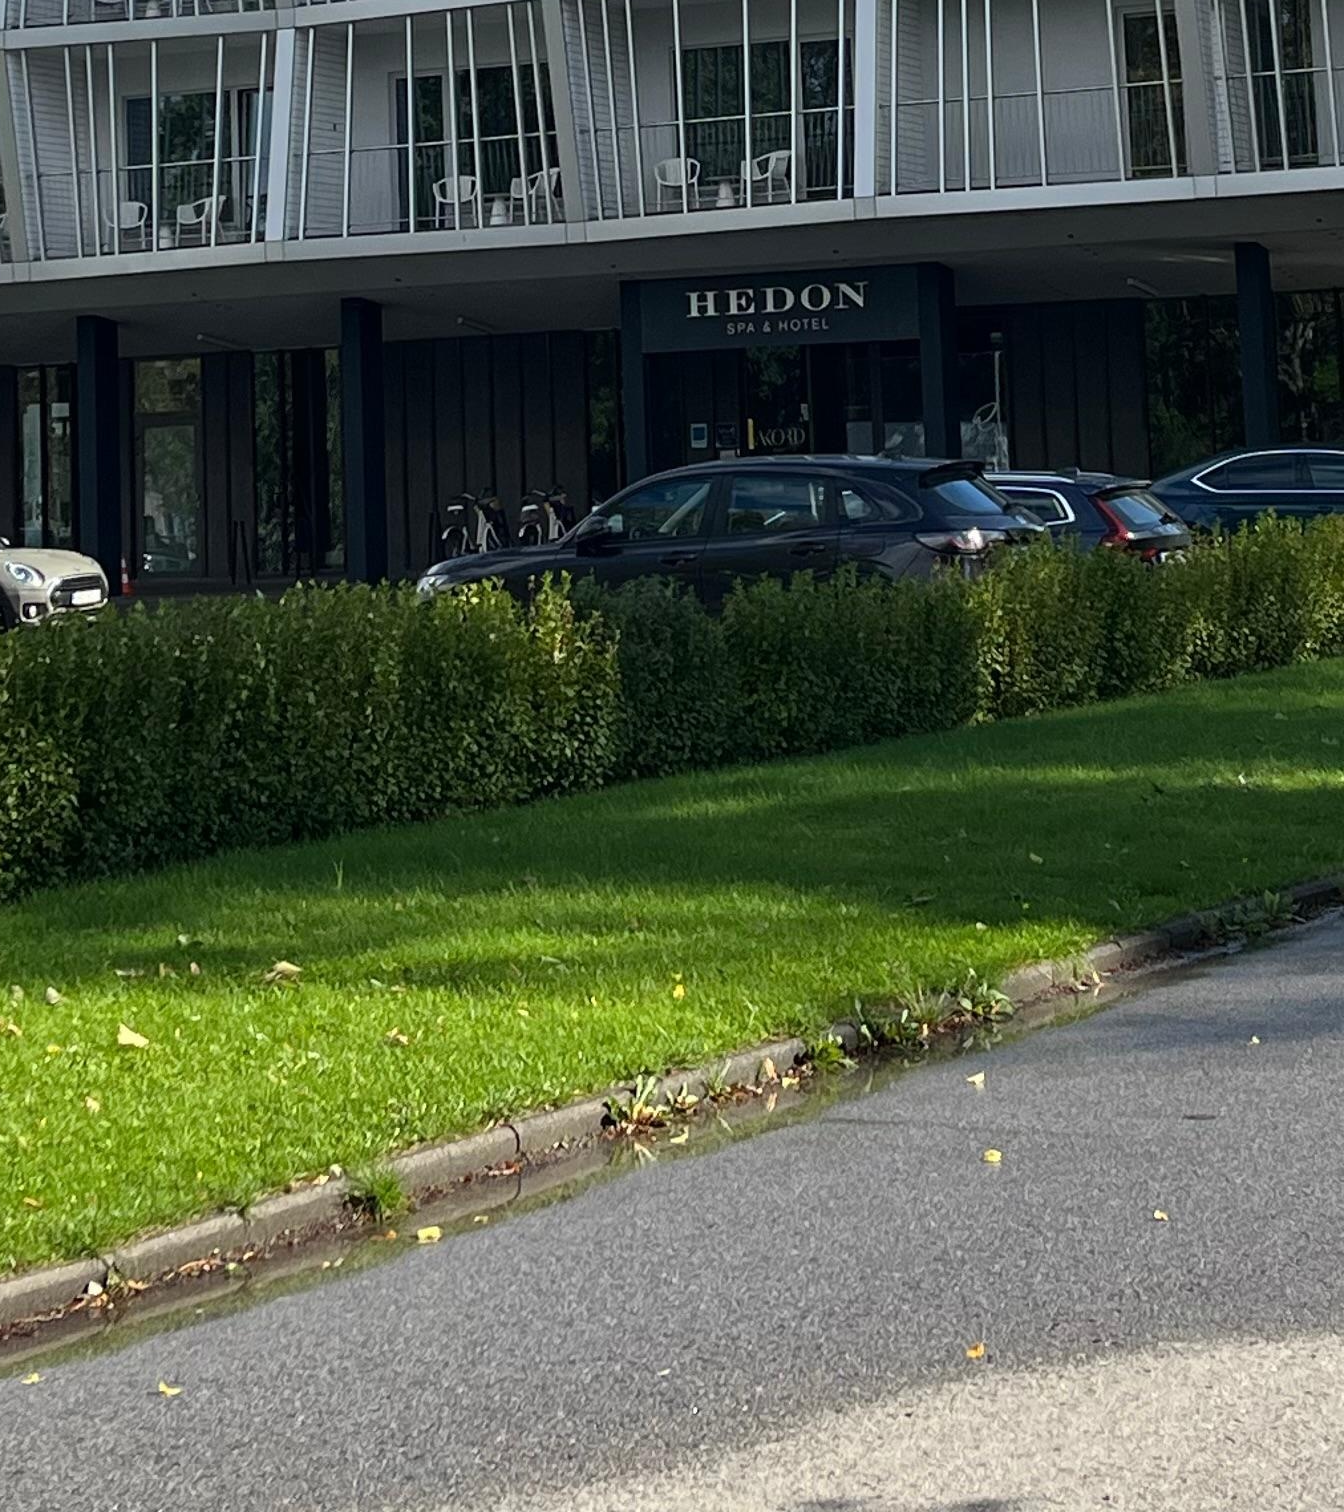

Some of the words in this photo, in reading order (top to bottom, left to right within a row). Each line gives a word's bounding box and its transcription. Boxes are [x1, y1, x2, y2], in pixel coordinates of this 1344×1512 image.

[685, 281, 869, 318] HEDON
[727, 321, 756, 335] SPA
[762, 320, 772, 333] &
[778, 317, 830, 332] HOTEL
